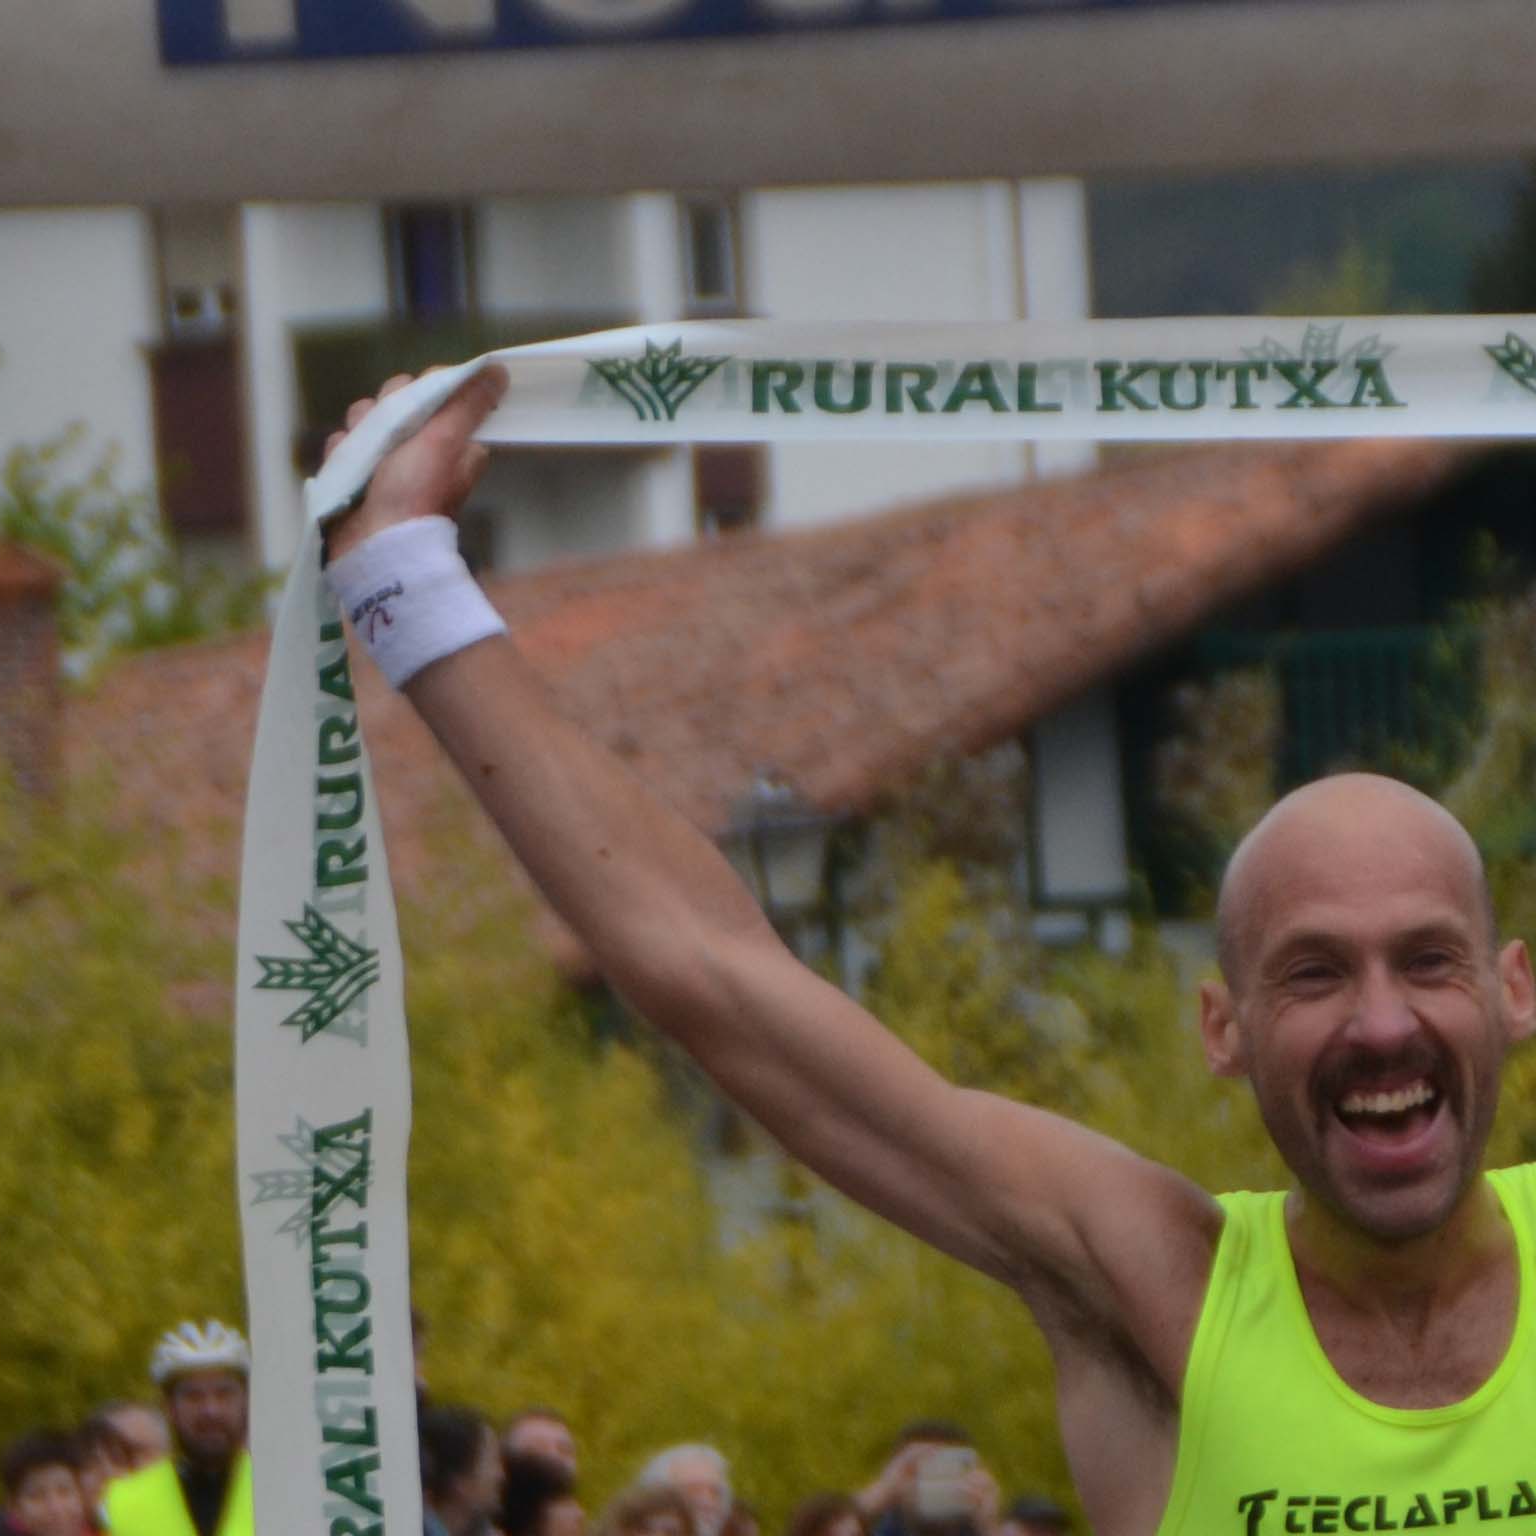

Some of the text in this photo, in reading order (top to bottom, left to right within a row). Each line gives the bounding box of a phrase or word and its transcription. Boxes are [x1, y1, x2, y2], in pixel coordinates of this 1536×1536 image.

[750, 358, 1409, 414] RURAL KUTXA
[311, 1108, 376, 1376] KUTXA
